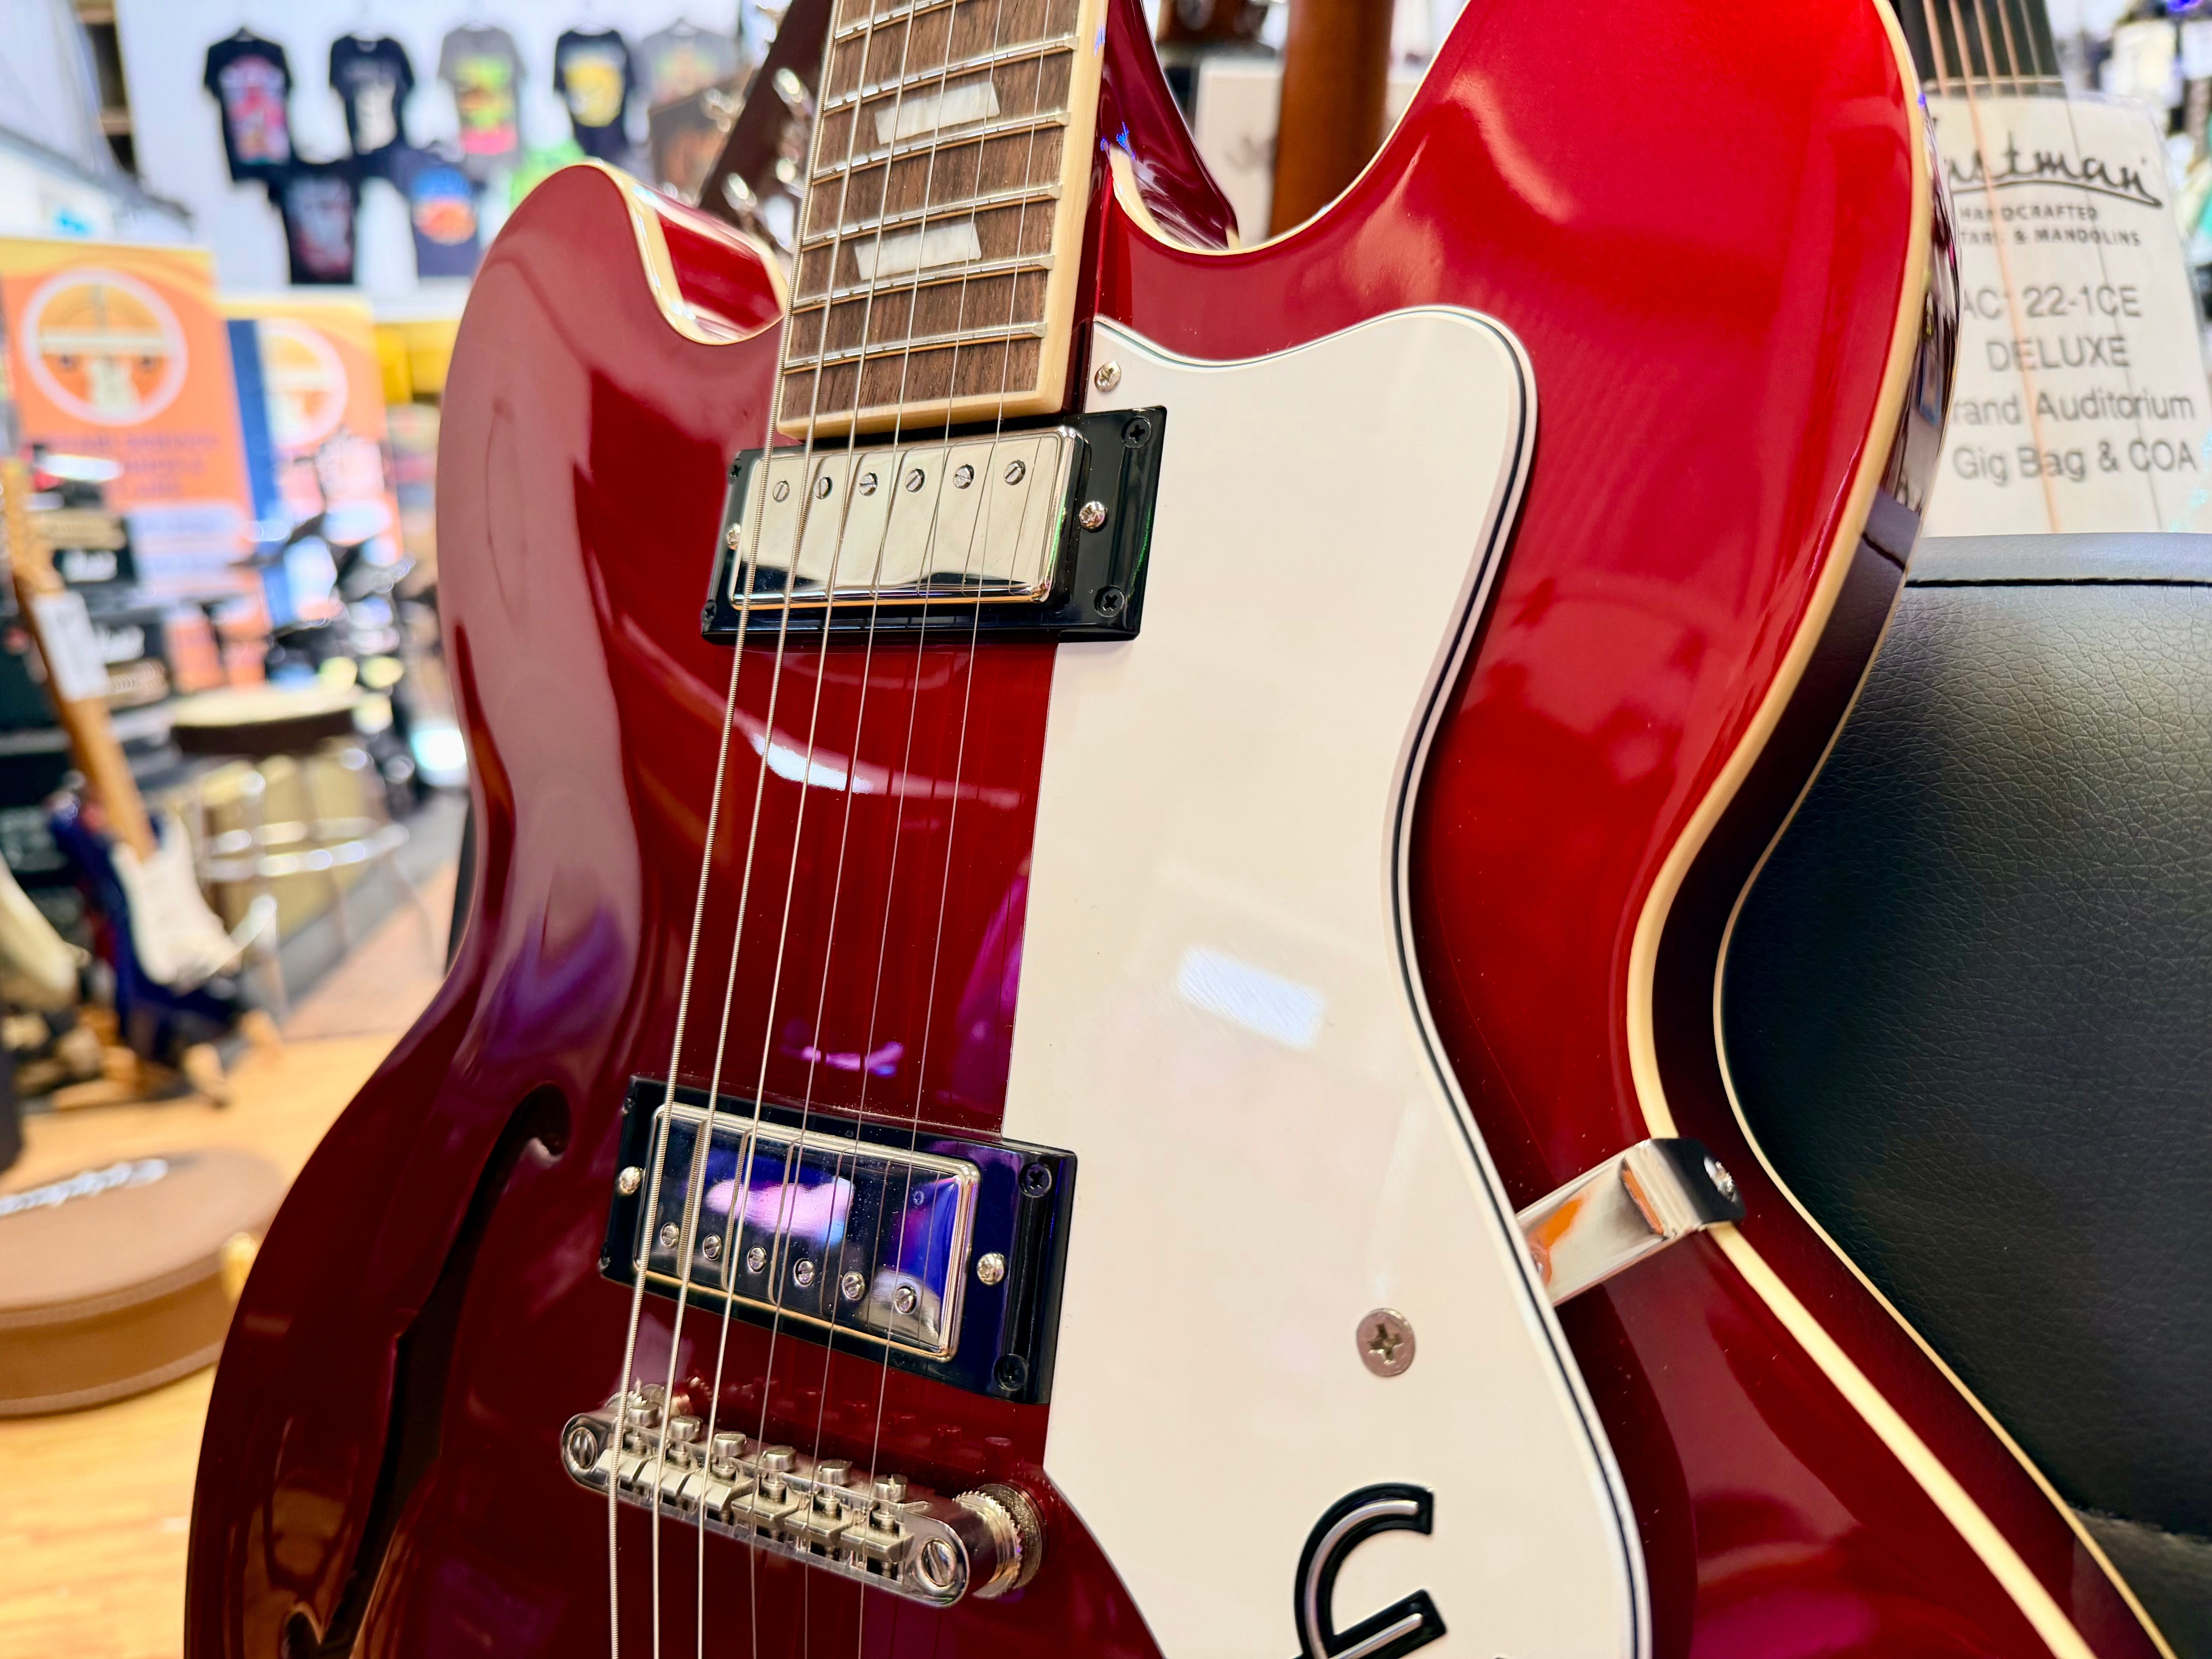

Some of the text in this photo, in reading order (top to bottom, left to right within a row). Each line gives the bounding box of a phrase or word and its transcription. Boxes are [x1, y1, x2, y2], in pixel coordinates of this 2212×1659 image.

[2034, 228, 2141, 246] MANDOLINS
[1986, 336, 2131, 372] DELUXE
[1953, 388, 2195, 425] rand Auditorium
[1952, 439, 2199, 488] Gig Bag & COA
